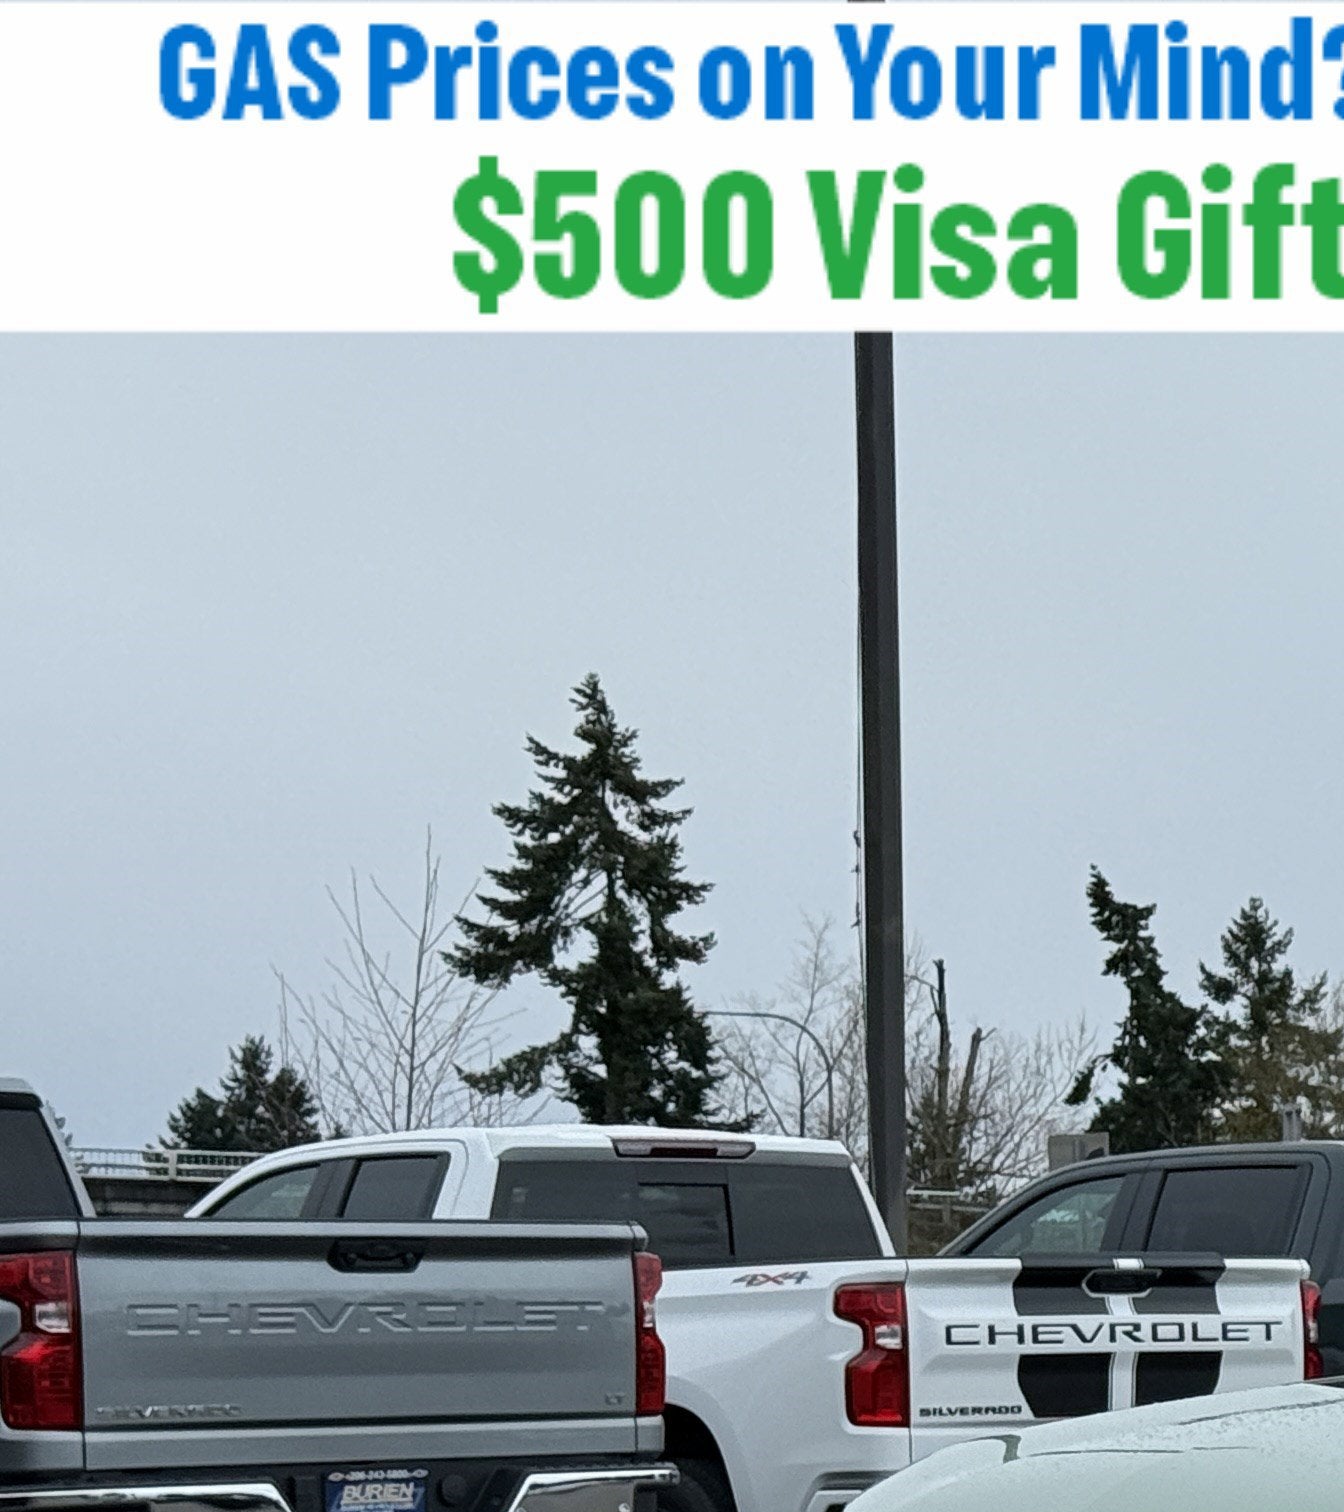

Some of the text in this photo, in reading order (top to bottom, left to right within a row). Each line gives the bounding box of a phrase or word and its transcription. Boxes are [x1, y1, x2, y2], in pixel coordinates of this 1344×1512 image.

[126, 1301, 606, 1336] CHEVROLET
[944, 1320, 1284, 1347] CHEVROLET
[918, 1405, 1023, 1417] SILVERADO
[341, 1482, 415, 1502] BURIEN
